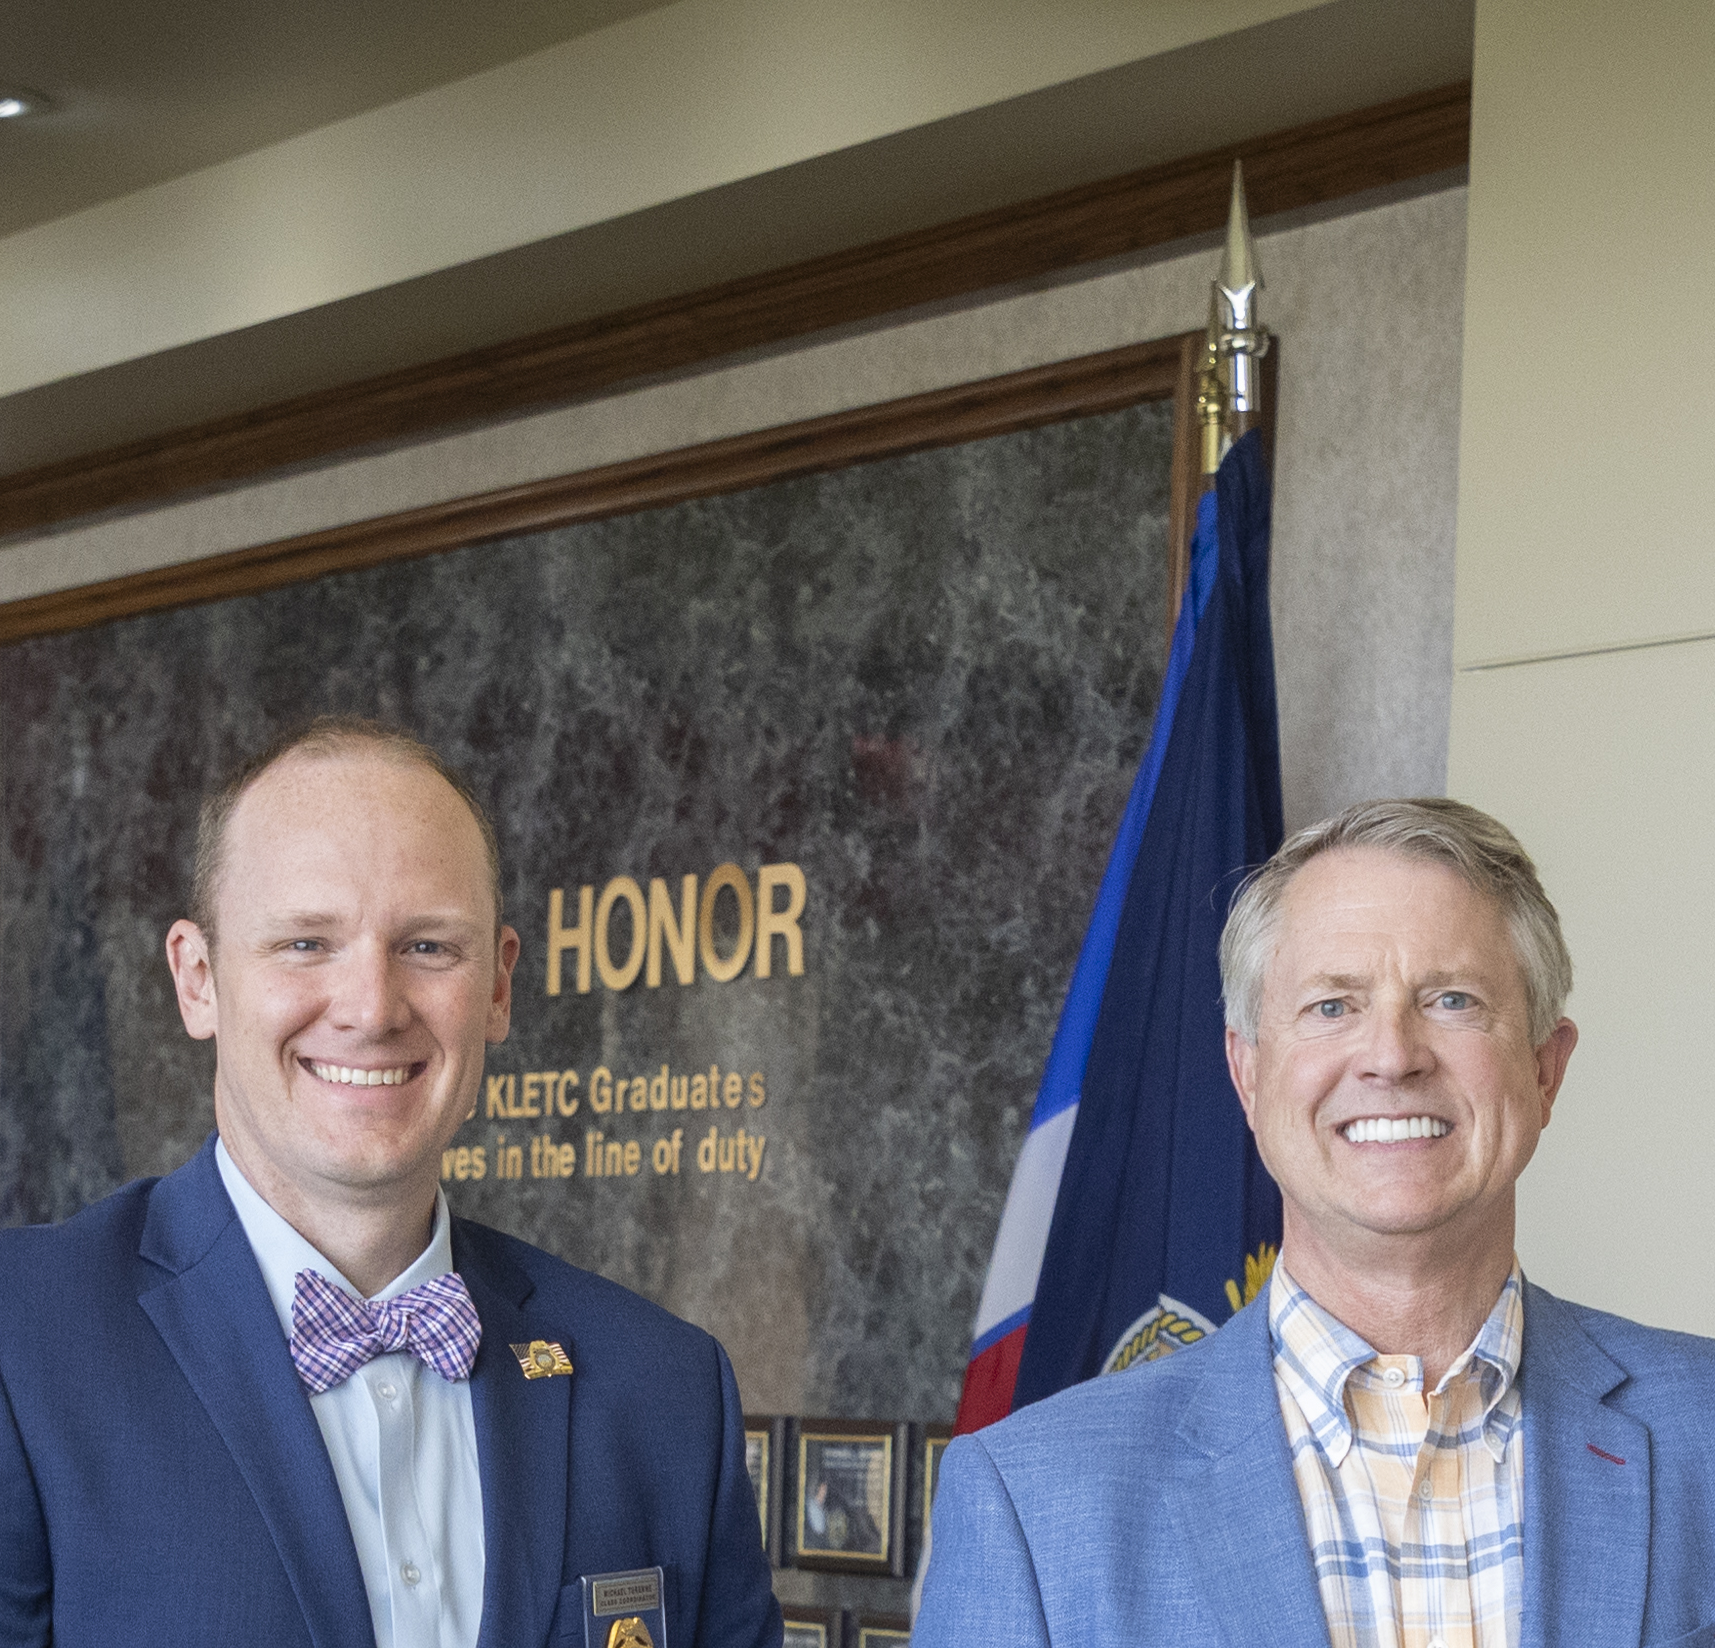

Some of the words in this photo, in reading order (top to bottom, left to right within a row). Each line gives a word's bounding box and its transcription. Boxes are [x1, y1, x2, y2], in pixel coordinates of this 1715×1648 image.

[547, 862, 806, 996] HONOR
[486, 1069, 580, 1119] KLETC
[589, 1066, 766, 1114] Graduates
[497, 1135, 523, 1179] in
[531, 1134, 577, 1178] the
[586, 1131, 641, 1177] line
[652, 1128, 682, 1175] of
[696, 1126, 766, 1181] duty
